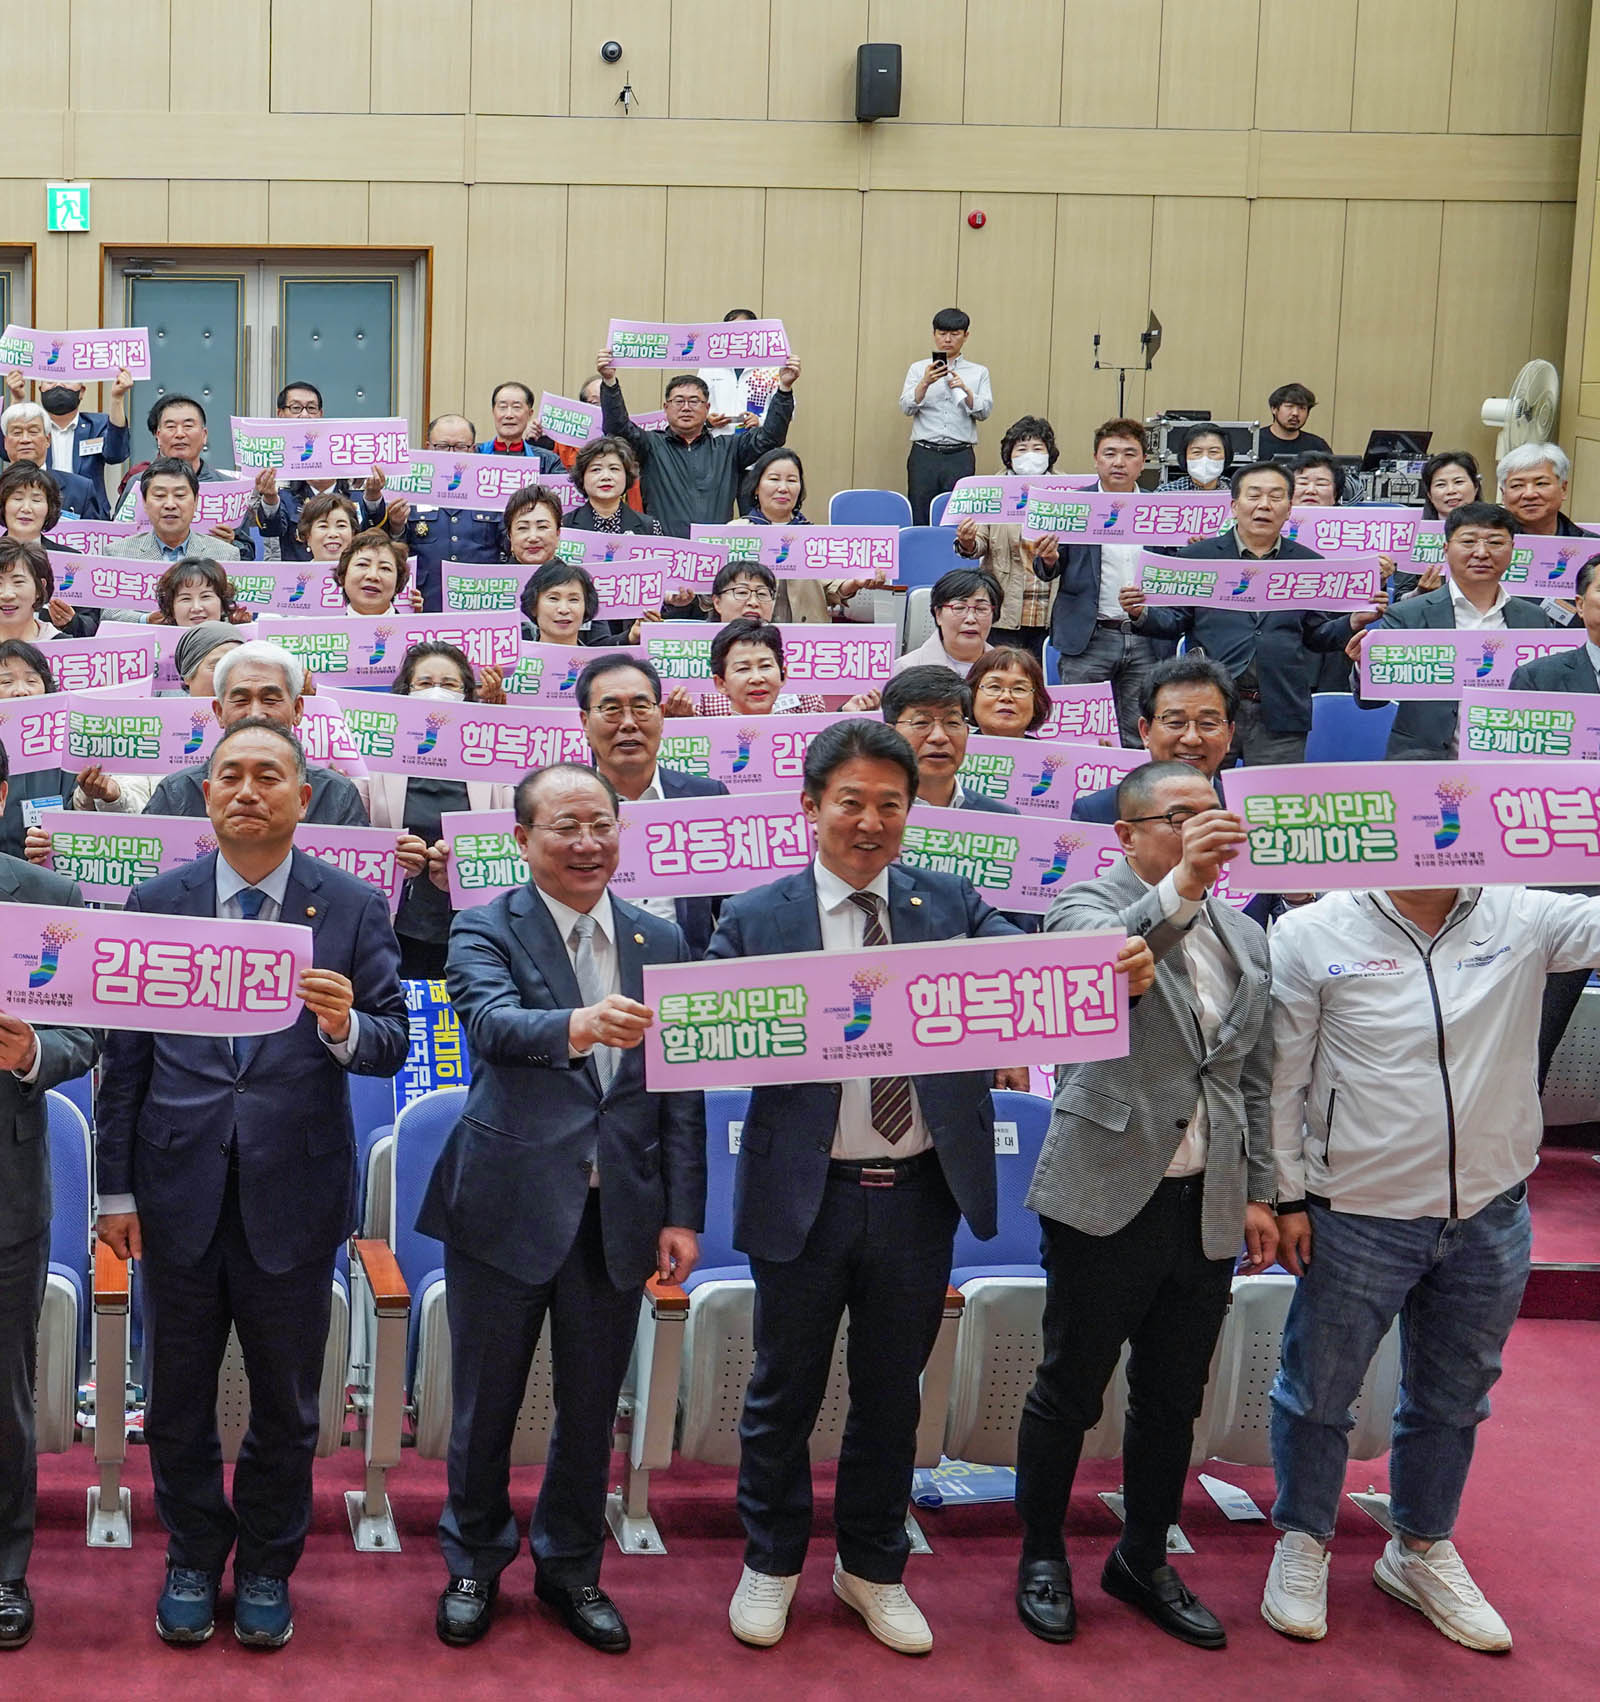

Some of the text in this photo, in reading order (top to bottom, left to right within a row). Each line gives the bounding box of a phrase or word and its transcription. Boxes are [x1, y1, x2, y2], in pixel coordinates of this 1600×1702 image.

[613, 332, 668, 347] 목포시민과
[613, 343, 667, 357] 함께하는
[707, 330, 787, 360] 행복체전
[72, 340, 145, 369] 감동체전
[542, 405, 592, 426] 목포시민과
[542, 413, 592, 437] 함께하는
[475, 465, 540, 498] 행복체
[1023, 499, 1090, 517] 목포시민과
[1029, 513, 1088, 530] 함께하는
[1134, 505, 1225, 535] 감동체전
[1314, 520, 1416, 552] 행복체전
[805, 537, 894, 568] 행복체전
[448, 576, 518, 595] 목포시민과
[591, 570, 663, 608] 복체전
[1142, 566, 1218, 586] 목포시민과
[1143, 579, 1216, 596] 함께하는
[1265, 570, 1375, 600] 감동체전
[450, 589, 517, 609] 함께하는
[648, 640, 712, 659] 목포시민
[784, 640, 891, 680] 감동체전
[1369, 645, 1456, 665] 목포시민과
[654, 655, 712, 678] 함께하
[1372, 660, 1454, 683] 함께하는
[70, 712, 163, 735] 목포시민과
[1468, 705, 1575, 731] 목포시민과
[71, 731, 160, 758] 함께하는
[460, 721, 589, 770] 행복체전
[658, 736, 711, 759] 시민과
[1470, 726, 1573, 754] 함께하는
[956, 754, 1014, 778] 시민과
[1244, 791, 1396, 827] 목포시민과
[1490, 787, 1600, 858] 행복
[51, 832, 163, 865] 목포시민과
[646, 816, 812, 876] 감동체전
[901, 825, 1019, 865] 목포시민과
[1248, 823, 1398, 865] 함께하는
[54, 855, 160, 886] 함께하는
[91, 938, 296, 1013] 감동체전
[658, 984, 808, 1026] 목포시민과
[905, 961, 1120, 1047] 행복체전
[660, 1018, 806, 1064] 함께하는
